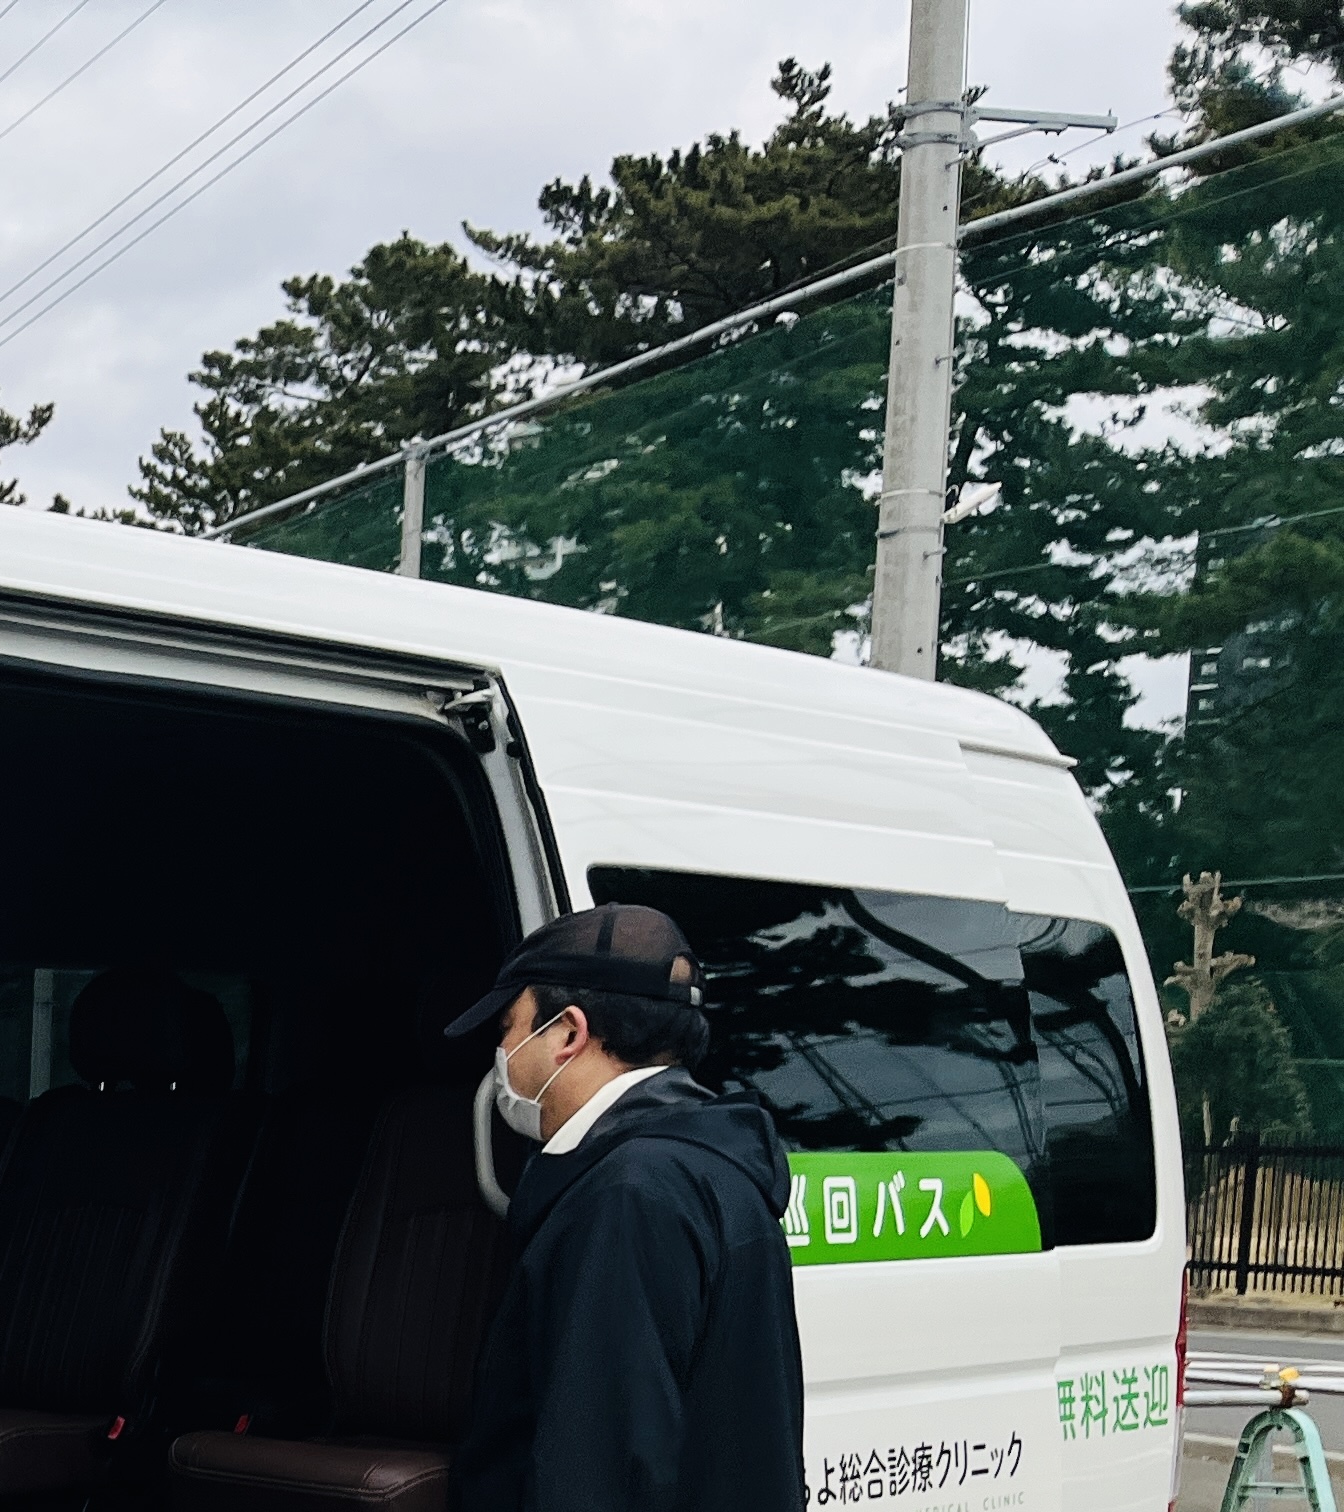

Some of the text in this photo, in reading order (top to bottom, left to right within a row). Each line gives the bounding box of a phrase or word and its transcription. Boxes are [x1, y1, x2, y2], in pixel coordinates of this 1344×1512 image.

[804, 1430, 1022, 1506] よ総合診療クリニック
[982, 1491, 1024, 1511] CLINIC
